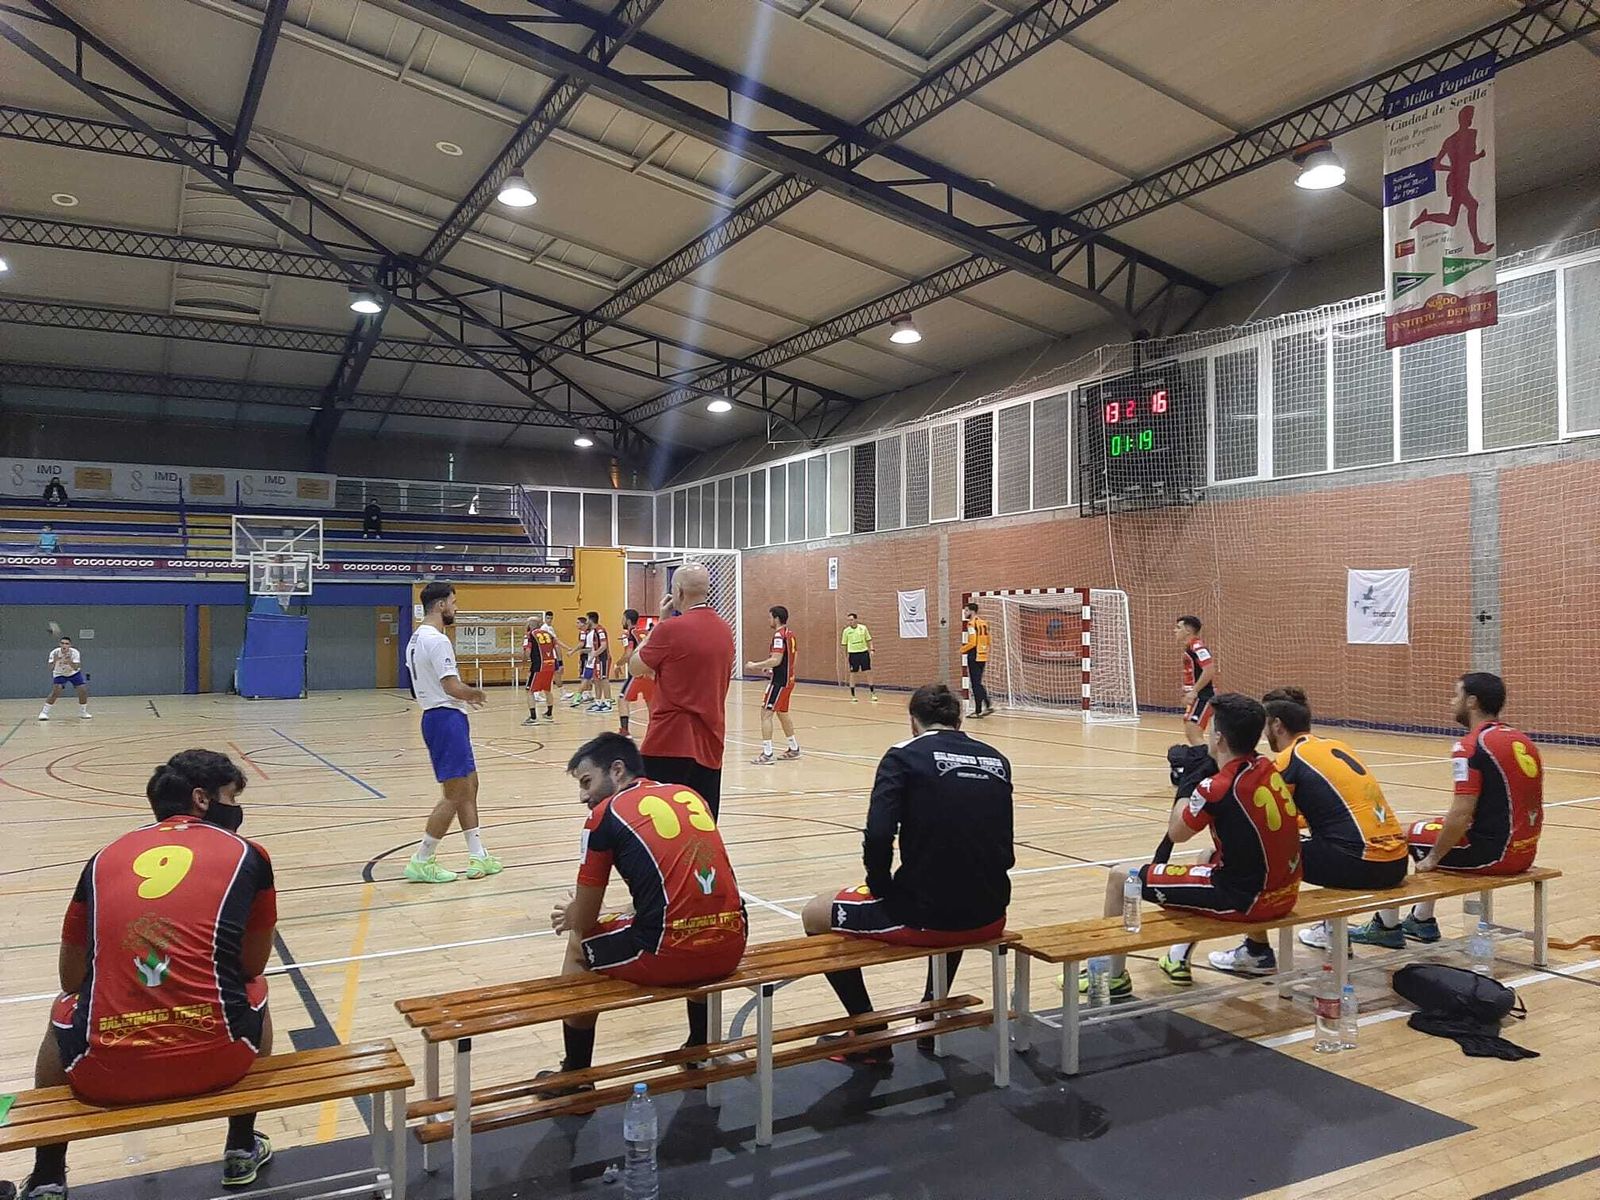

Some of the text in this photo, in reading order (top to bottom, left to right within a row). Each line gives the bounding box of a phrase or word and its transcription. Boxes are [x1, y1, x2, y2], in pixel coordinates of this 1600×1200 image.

[1403, 89, 1434, 109] Milla
[1438, 67, 1492, 95] Popular
[1432, 105, 1446, 116] de
[1447, 301, 1492, 318] DEPORTES
[1106, 391, 1167, 423] 13 2 16
[1111, 429, 1153, 456] 01:19
[37, 464, 62, 475] IMD
[154, 471, 178, 482] IMD
[264, 475, 287, 485] IMD
[464, 626, 486, 636] IMD
[536, 632, 552, 644] 23
[1511, 741, 1539, 778] 6
[638, 790, 716, 840] 13
[132, 845, 194, 900] 9
